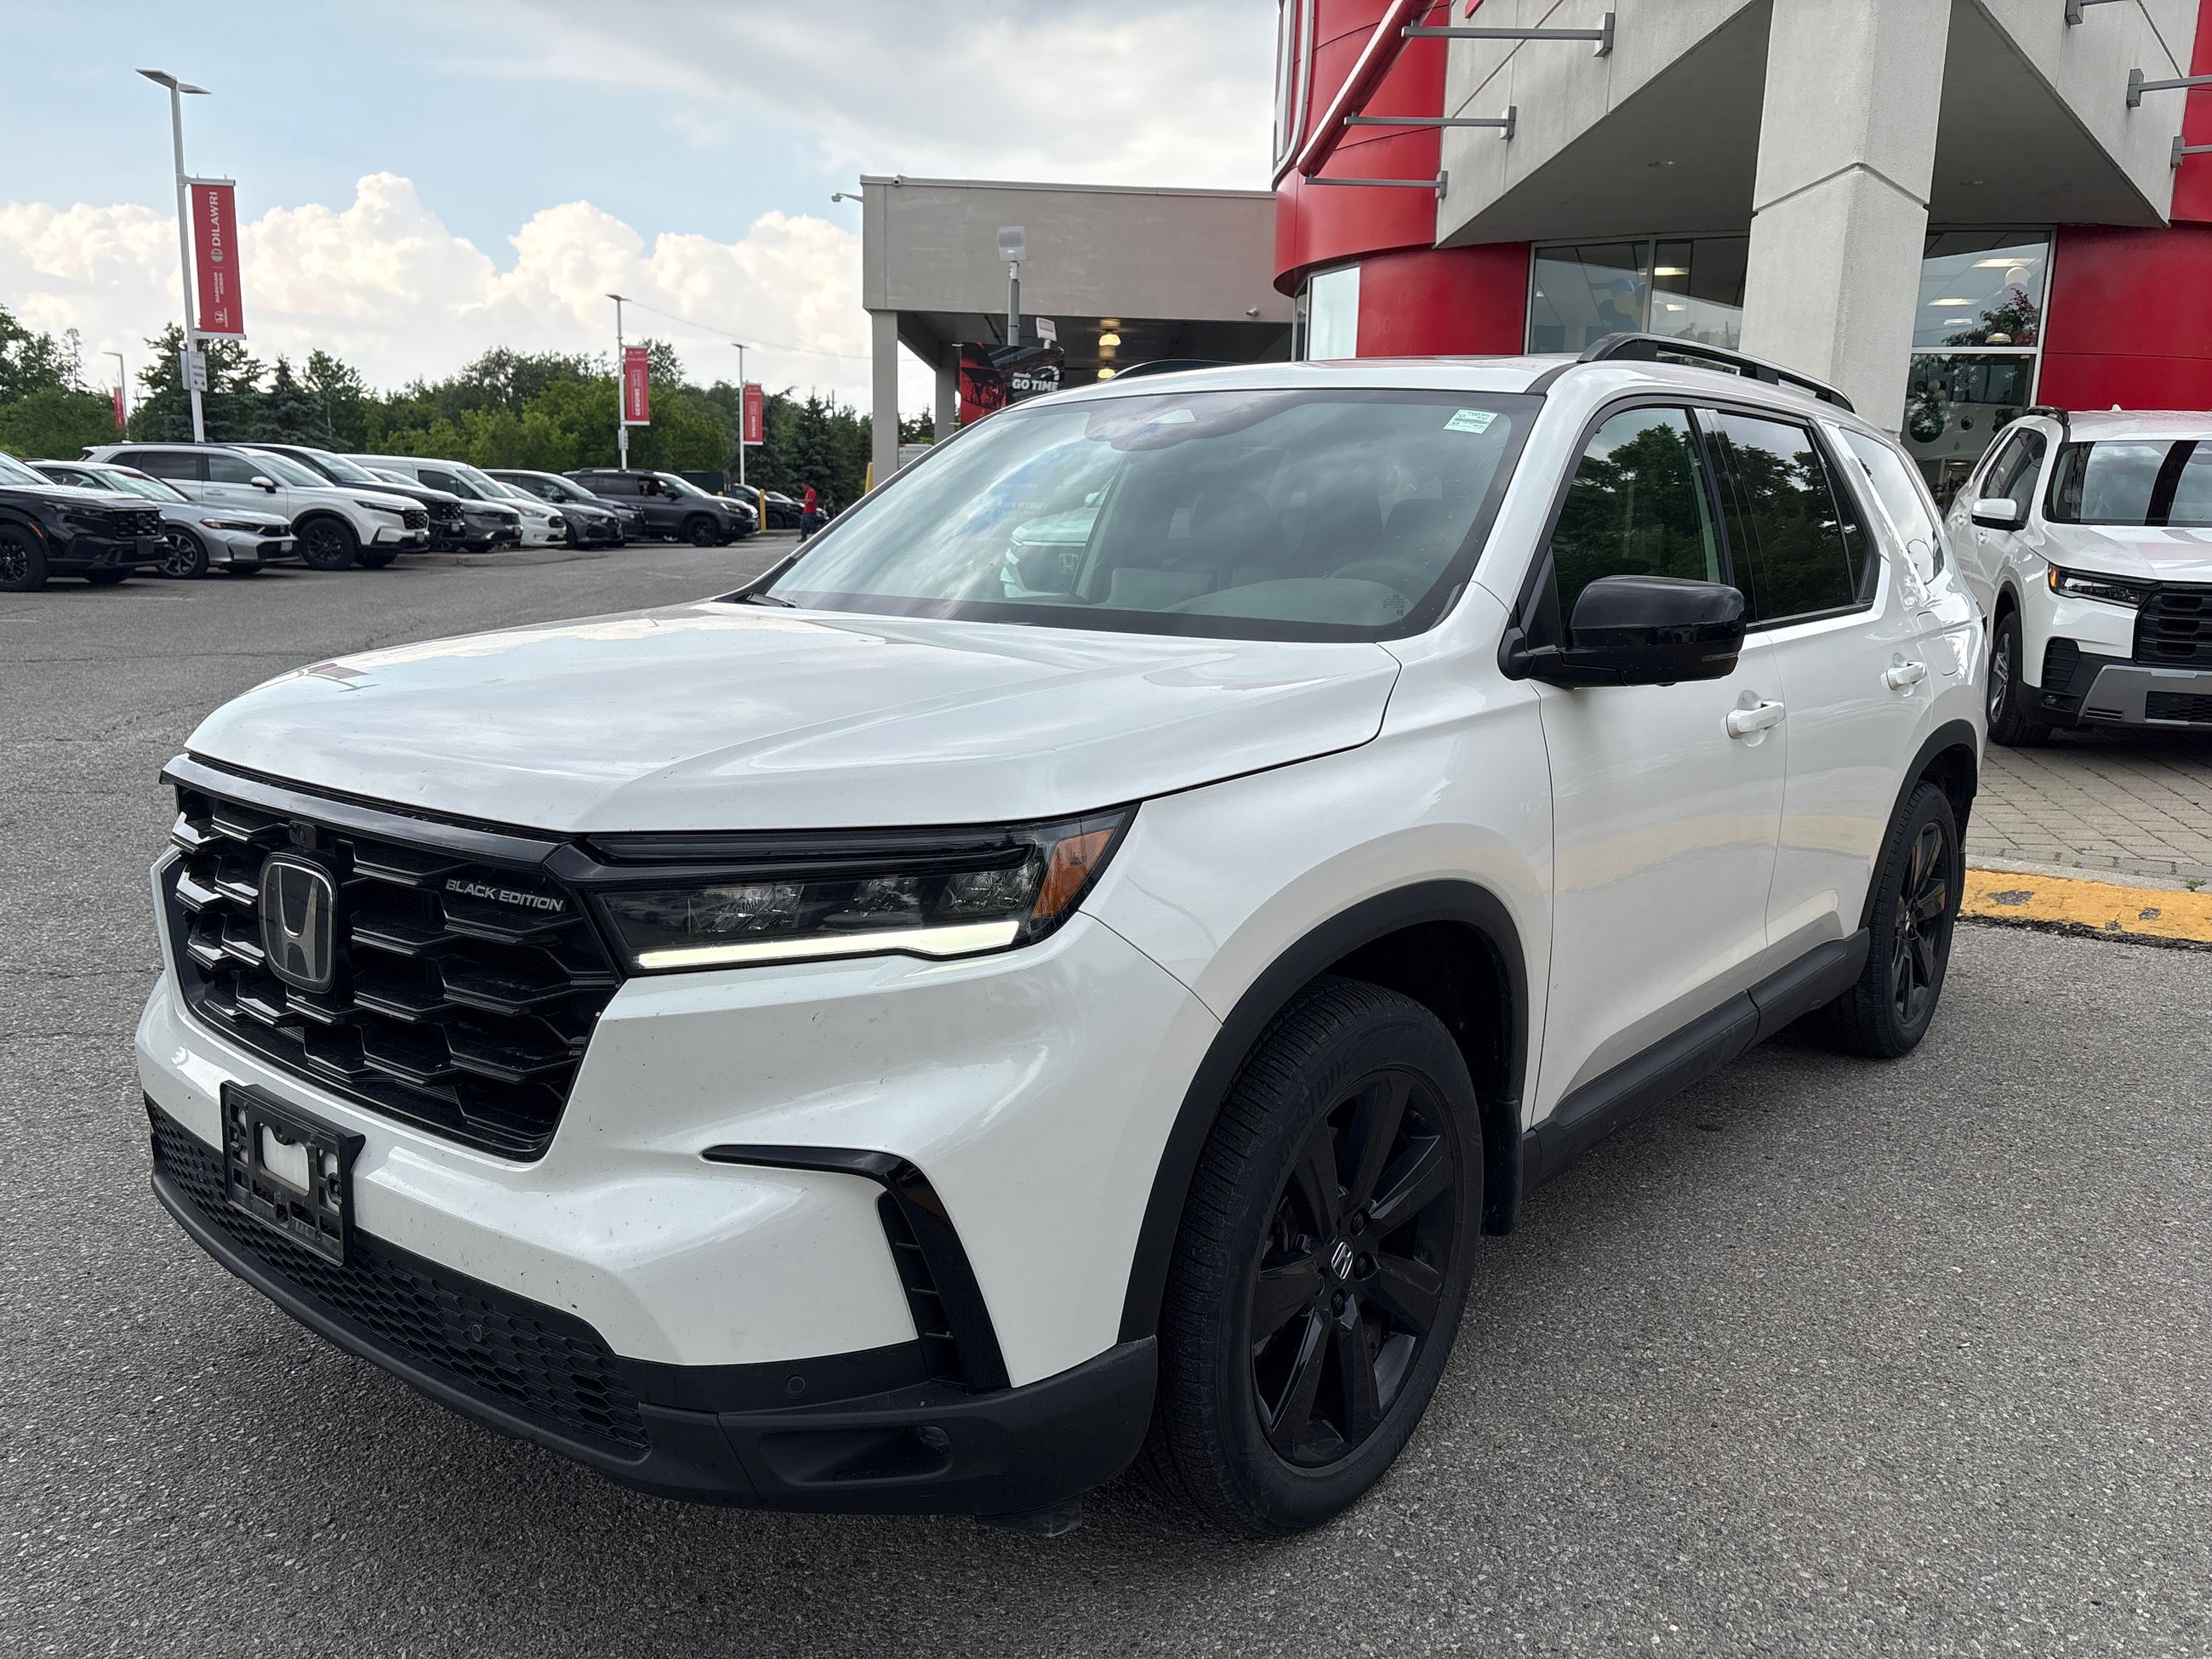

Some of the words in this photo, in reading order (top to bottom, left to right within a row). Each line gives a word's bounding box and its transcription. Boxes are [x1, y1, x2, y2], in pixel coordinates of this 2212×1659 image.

[209, 191, 221, 247] DILAWRI
[1012, 379, 1030, 390] GO
[1032, 380, 1058, 391] TIME
[445, 879, 497, 900] BLACK
[498, 890, 564, 912] EDITION
